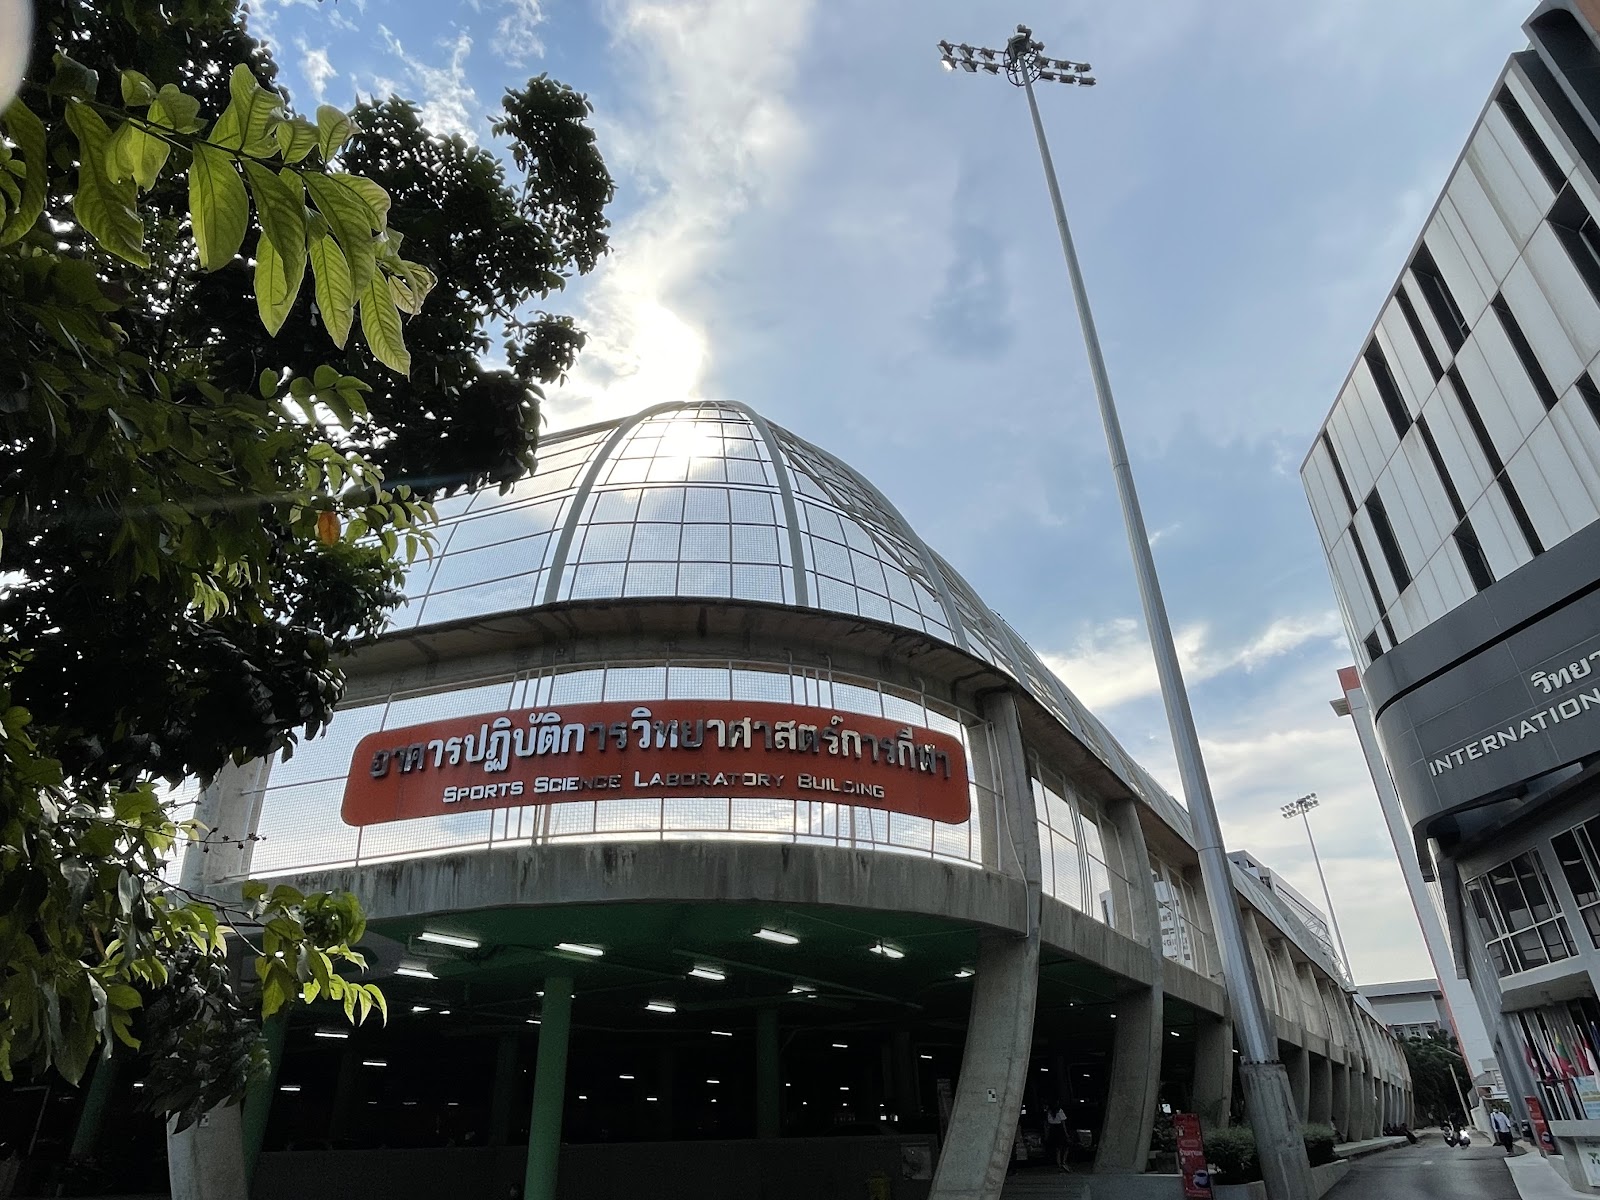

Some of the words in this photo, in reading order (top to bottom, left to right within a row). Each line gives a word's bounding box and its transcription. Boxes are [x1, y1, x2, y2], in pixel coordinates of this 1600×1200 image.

[370, 706, 950, 779] อาคารปฏิบัติการวิทยาศาสตร์การกีฬา
[443, 781, 524, 803] SPORTS
[533, 774, 622, 793] SCIENCE
[634, 770, 785, 788] LABORATORY
[797, 773, 885, 798] BUILDING
